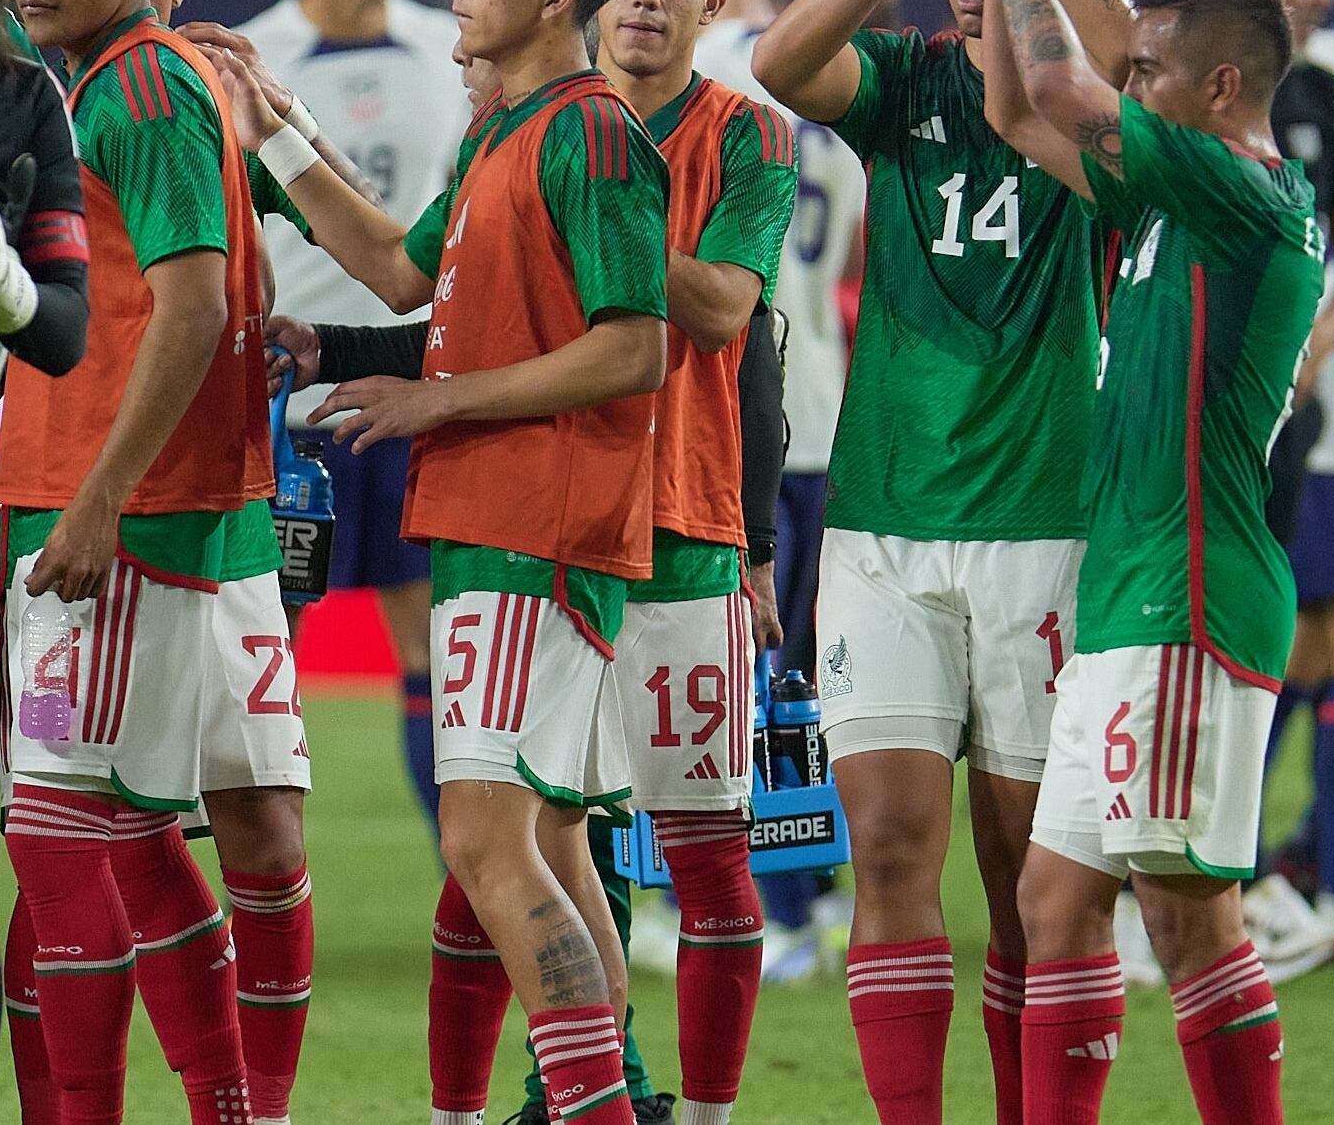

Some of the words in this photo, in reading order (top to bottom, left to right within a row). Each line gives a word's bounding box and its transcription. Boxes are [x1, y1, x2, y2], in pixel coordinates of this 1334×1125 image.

[932, 172, 1019, 258] 14
[443, 613, 482, 694] 5
[644, 664, 727, 748] 19
[1103, 701, 1139, 784] 6
[694, 915, 755, 930] MÉXICO
